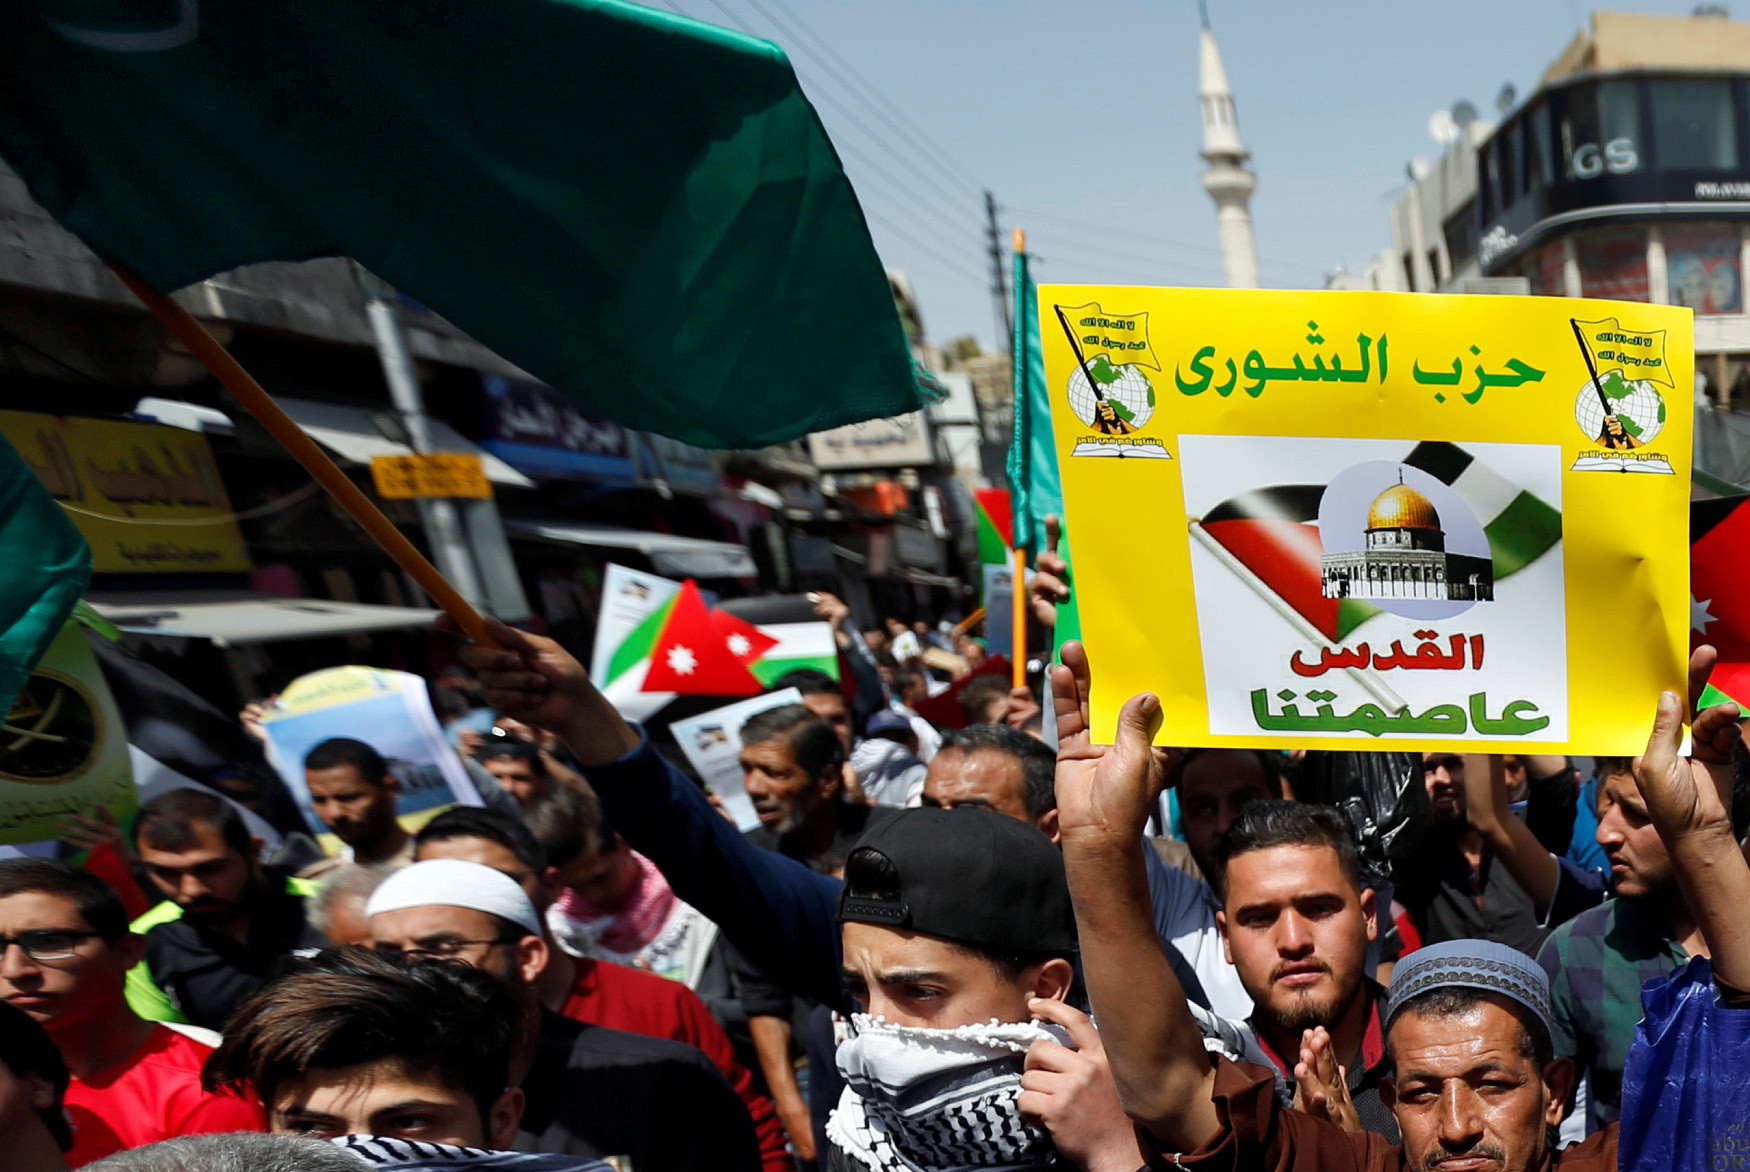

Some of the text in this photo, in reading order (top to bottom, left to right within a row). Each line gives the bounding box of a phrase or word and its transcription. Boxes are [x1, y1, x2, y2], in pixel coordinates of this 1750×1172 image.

[1080, 317, 1096, 327] الله
[1083, 335, 1100, 345] الله
[1596, 333, 1613, 342] الله
[1598, 350, 1615, 360] الله
[1175, 319, 1547, 404] حزب الشورى
[1290, 629, 1484, 677] القدس
[1251, 688, 1550, 737] عاصمتنا
